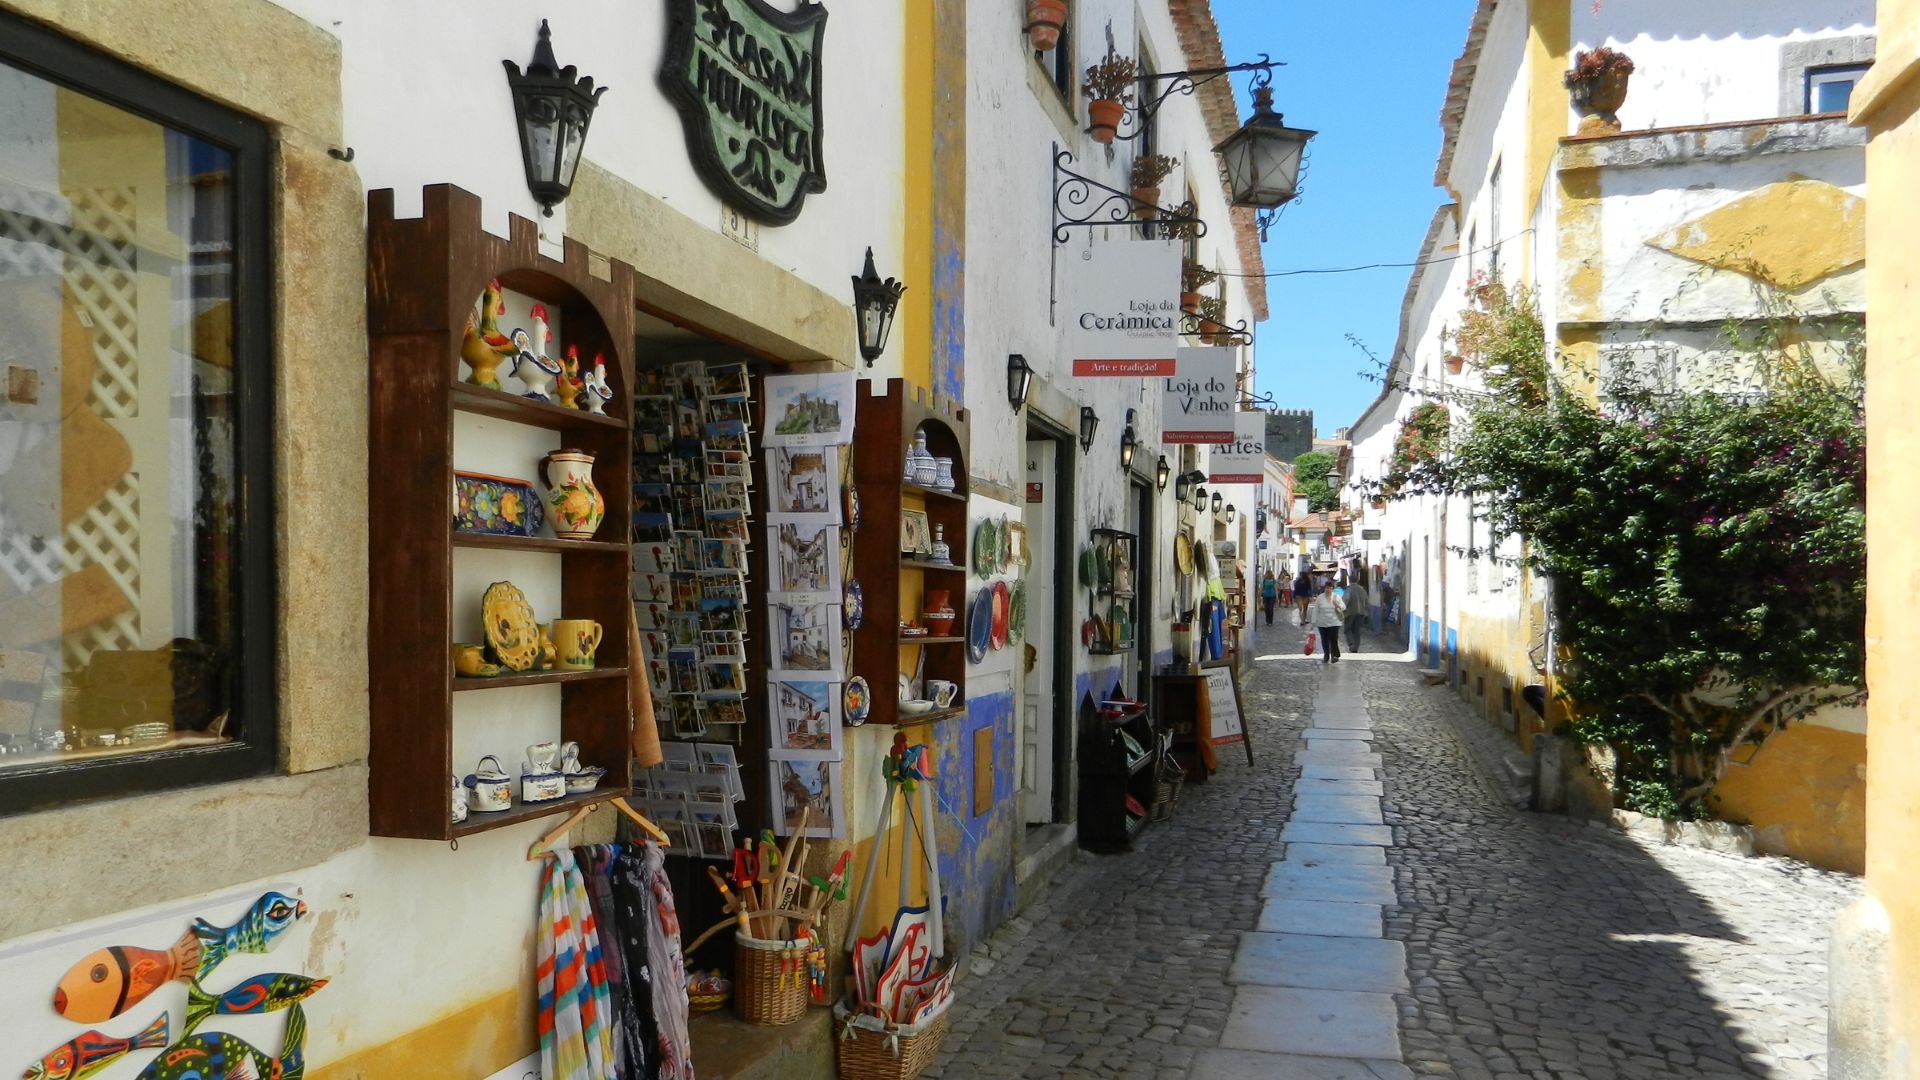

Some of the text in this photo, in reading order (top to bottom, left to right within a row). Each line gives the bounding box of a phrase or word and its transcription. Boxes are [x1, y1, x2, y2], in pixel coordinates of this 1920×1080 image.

[1129, 300, 1173, 313] Loja da
[1079, 312, 1172, 330] Cerâmica
[1092, 363, 1110, 372] Arte
[1120, 362, 1157, 373] tradição!
[1166, 377, 1225, 396] Loja do
[1212, 440, 1263, 454] Artes
